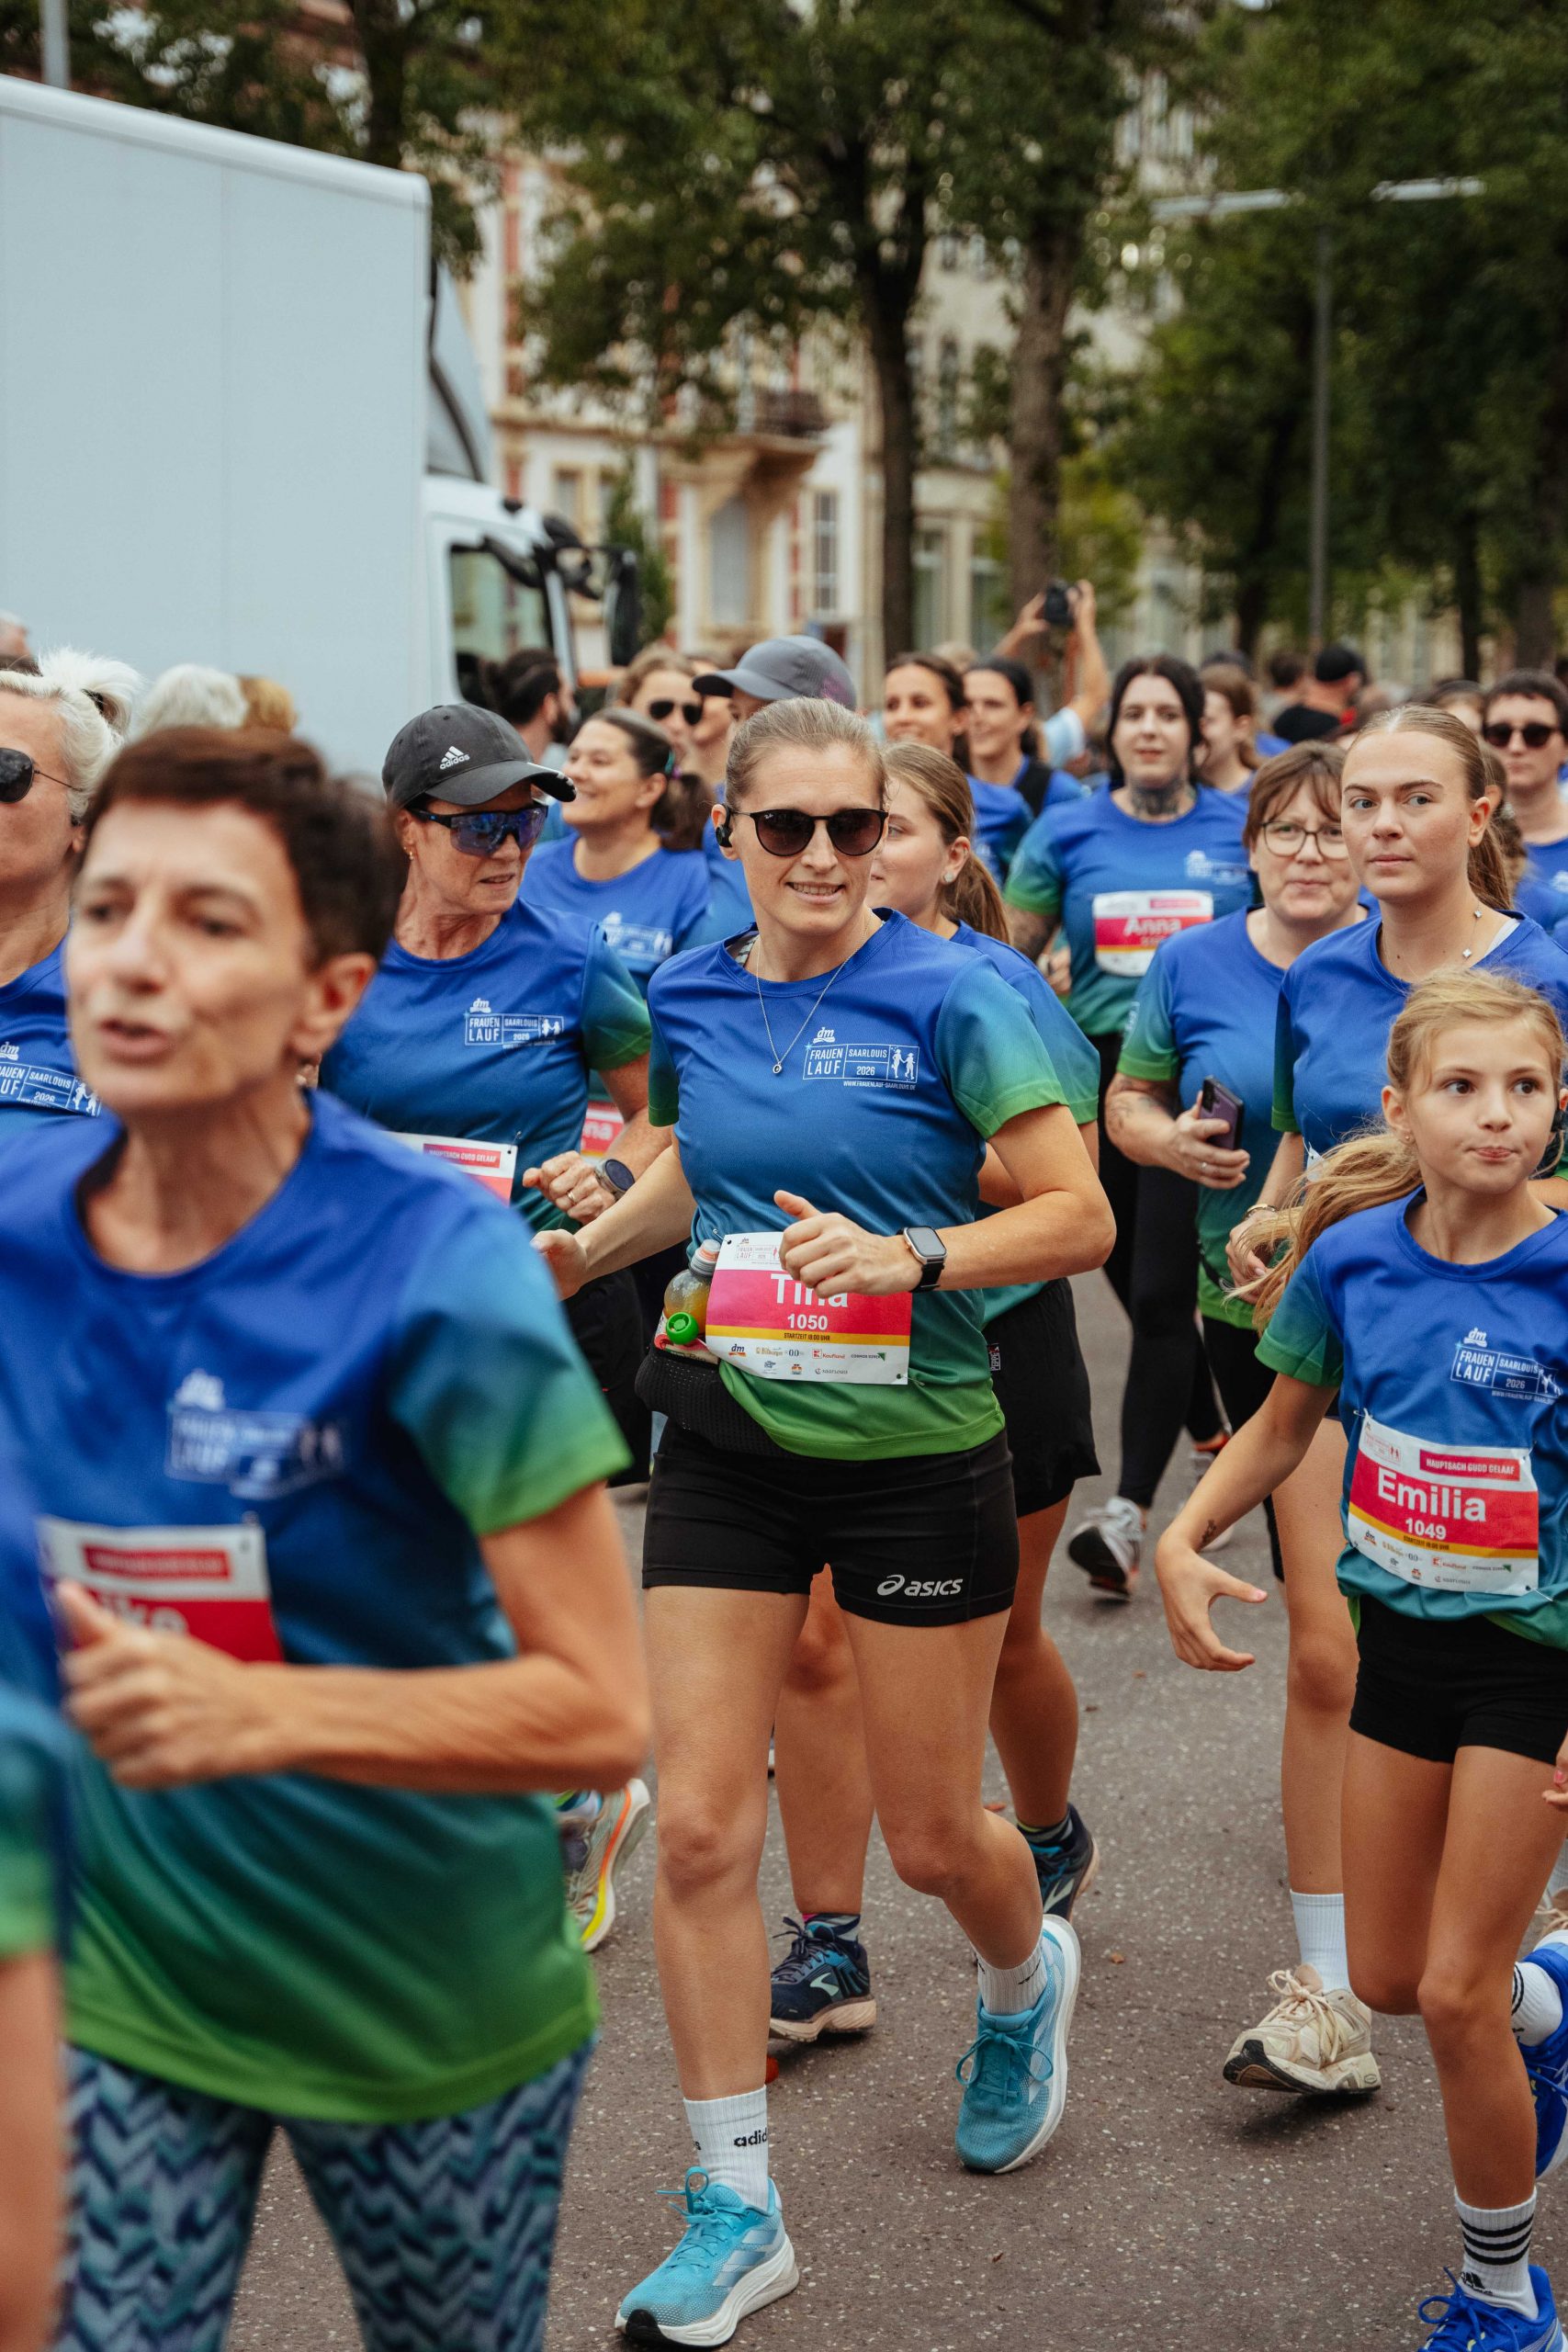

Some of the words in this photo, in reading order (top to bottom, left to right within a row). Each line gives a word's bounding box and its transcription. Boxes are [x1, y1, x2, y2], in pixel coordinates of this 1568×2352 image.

[440, 753, 469, 770] adidas
[1123, 917, 1182, 936] Anna
[472, 998, 490, 1008] dm
[469, 1017, 501, 1028] FRAUEN
[504, 1018, 537, 1027] SAARLOUIS
[468, 1028, 500, 1042] LAUF
[817, 1027, 835, 1038] dm
[810, 1048, 843, 1060] FRAUEN
[849, 1049, 887, 1058] SAARLOUIS
[0, 1066, 26, 1080] AUEN
[807, 1060, 841, 1075] LAUF
[856, 1066, 875, 1076] 2026
[29, 1071, 72, 1089] SAARLOUIS
[787, 1313, 829, 1330] 1050
[1468, 1327, 1487, 1341] dm
[731, 1343, 745, 1352] dm
[1460, 1350, 1495, 1367] FRAUEN
[1456, 1363, 1492, 1382] LAUF
[1499, 1359, 1539, 1374] SAARLOUIS
[1506, 1378, 1526, 1389] 2026
[1426, 1458, 1467, 1472] HAUPTSACH
[1468, 1463, 1487, 1473] GUDD
[1488, 1464, 1515, 1475] GELAAF
[1378, 1466, 1486, 1522] Emilia
[1405, 1518, 1447, 1541] 1049
[904, 1578, 964, 1597] asics
